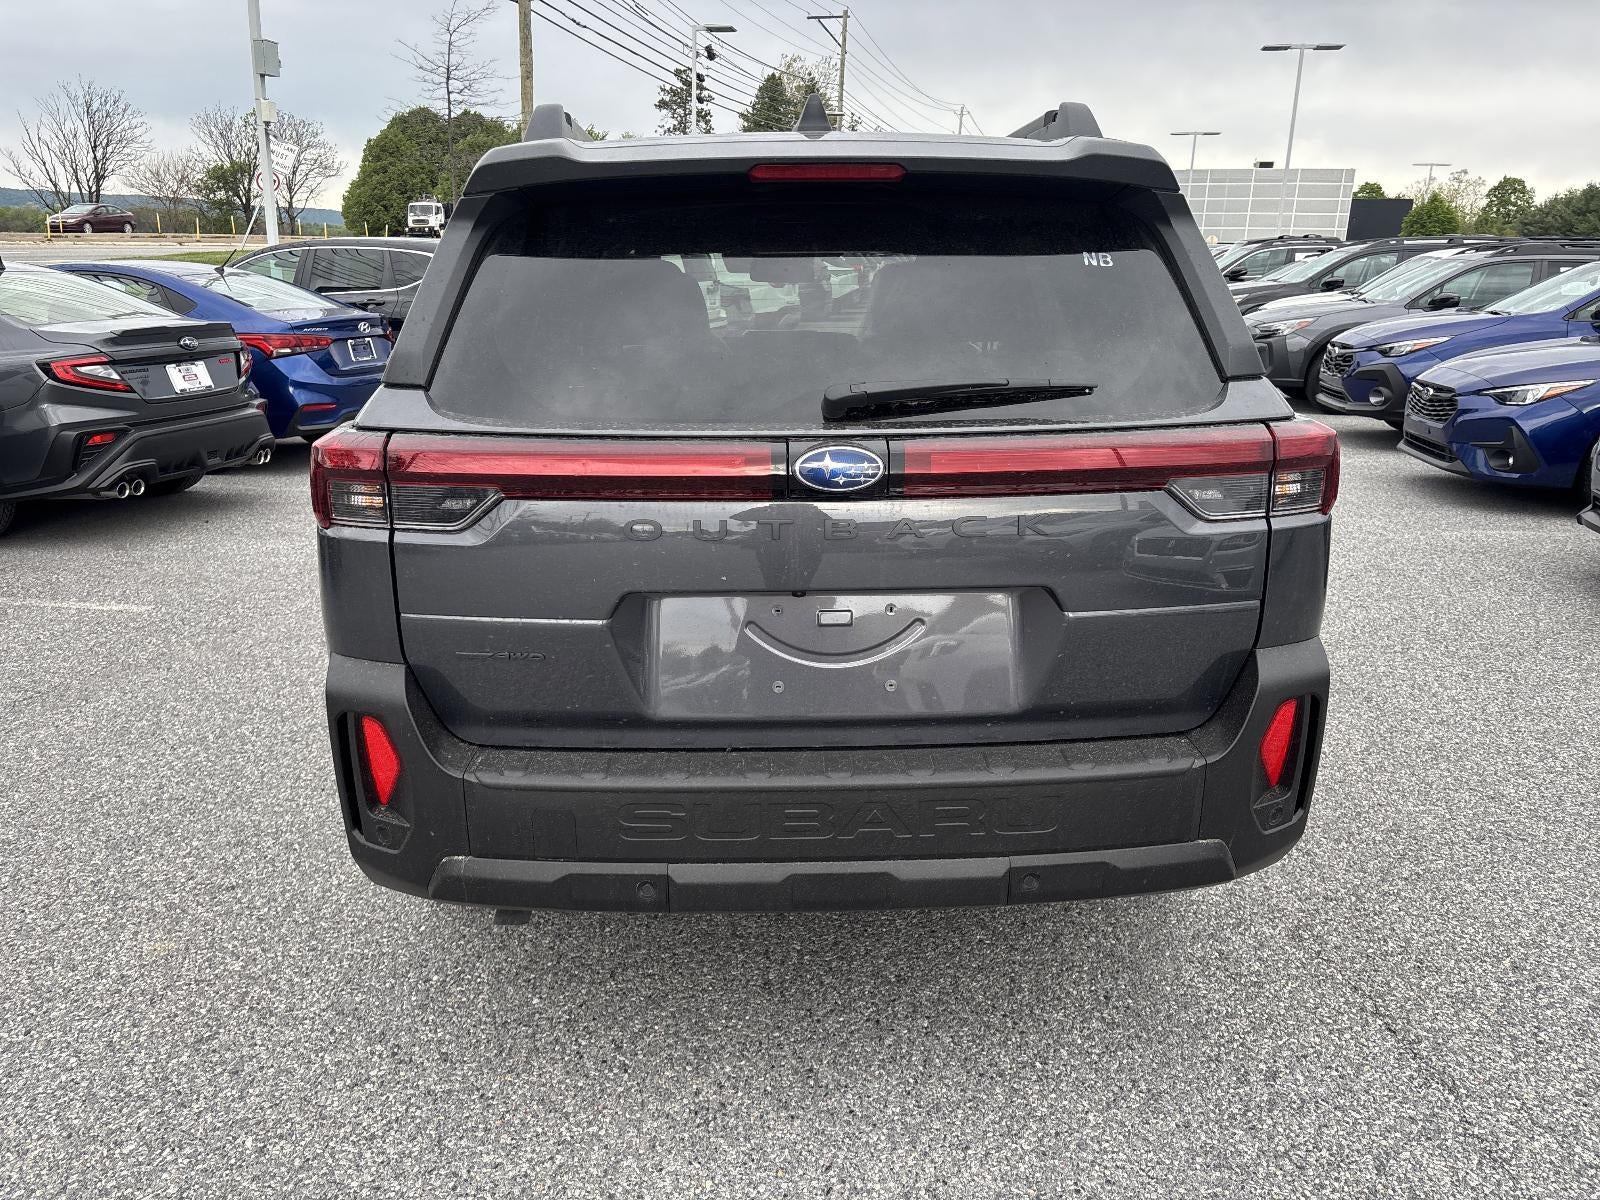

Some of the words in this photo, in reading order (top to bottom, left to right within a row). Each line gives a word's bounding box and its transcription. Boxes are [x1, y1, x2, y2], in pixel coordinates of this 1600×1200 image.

[271, 149, 288, 160] MUST
[1083, 251, 1113, 266] NB
[624, 514, 1050, 542] OUTBACK
[617, 798, 1061, 841] SUBARU
